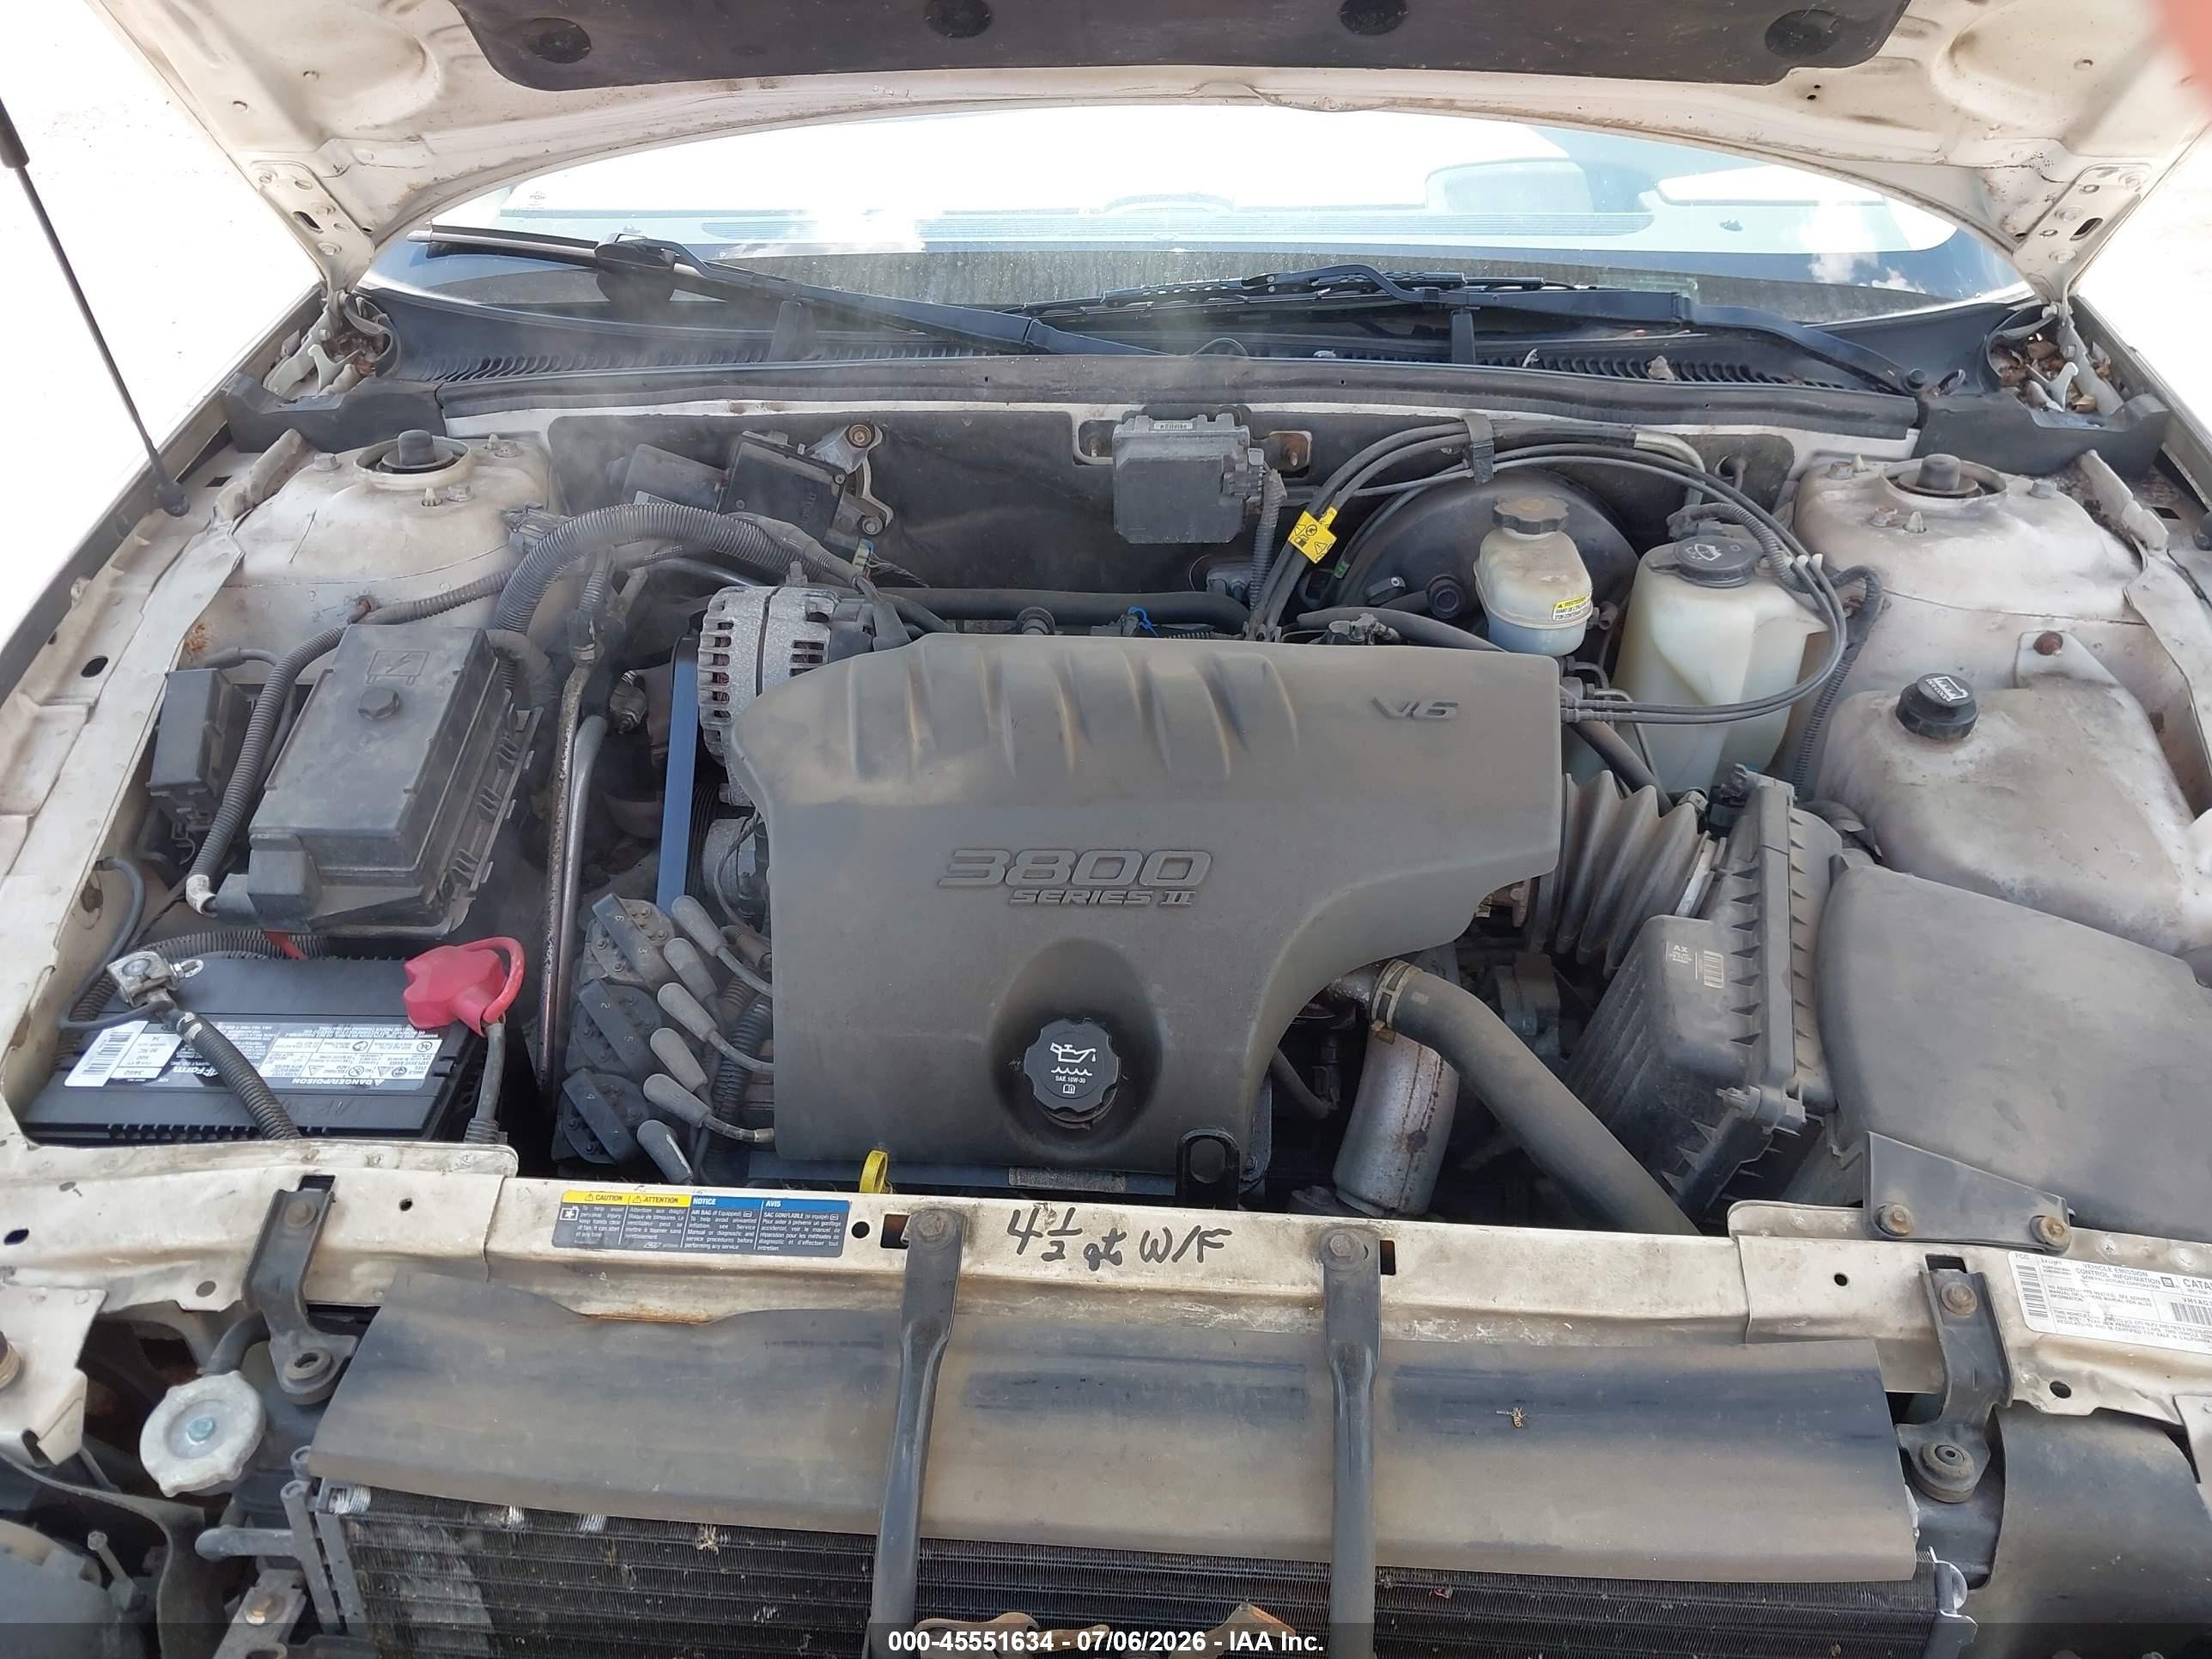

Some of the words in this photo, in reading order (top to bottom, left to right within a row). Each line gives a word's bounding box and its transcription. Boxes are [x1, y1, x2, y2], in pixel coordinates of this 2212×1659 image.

[1373, 697, 1459, 721] V6
[938, 848, 1215, 888] 3800
[1009, 889, 1154, 906] SERIES
[595, 1194, 623, 1203] CAUTION
[643, 1195, 678, 1204] ATTENTION
[692, 1197, 717, 1206] NOTICE
[765, 1200, 781, 1208] AVIS
[2075, 1267, 2110, 1278] CONTROL
[2112, 1273, 2160, 1285] INFORMATION
[2082, 1263, 2113, 1273] VEHICLE
[2114, 1267, 2148, 1277] EMISSION
